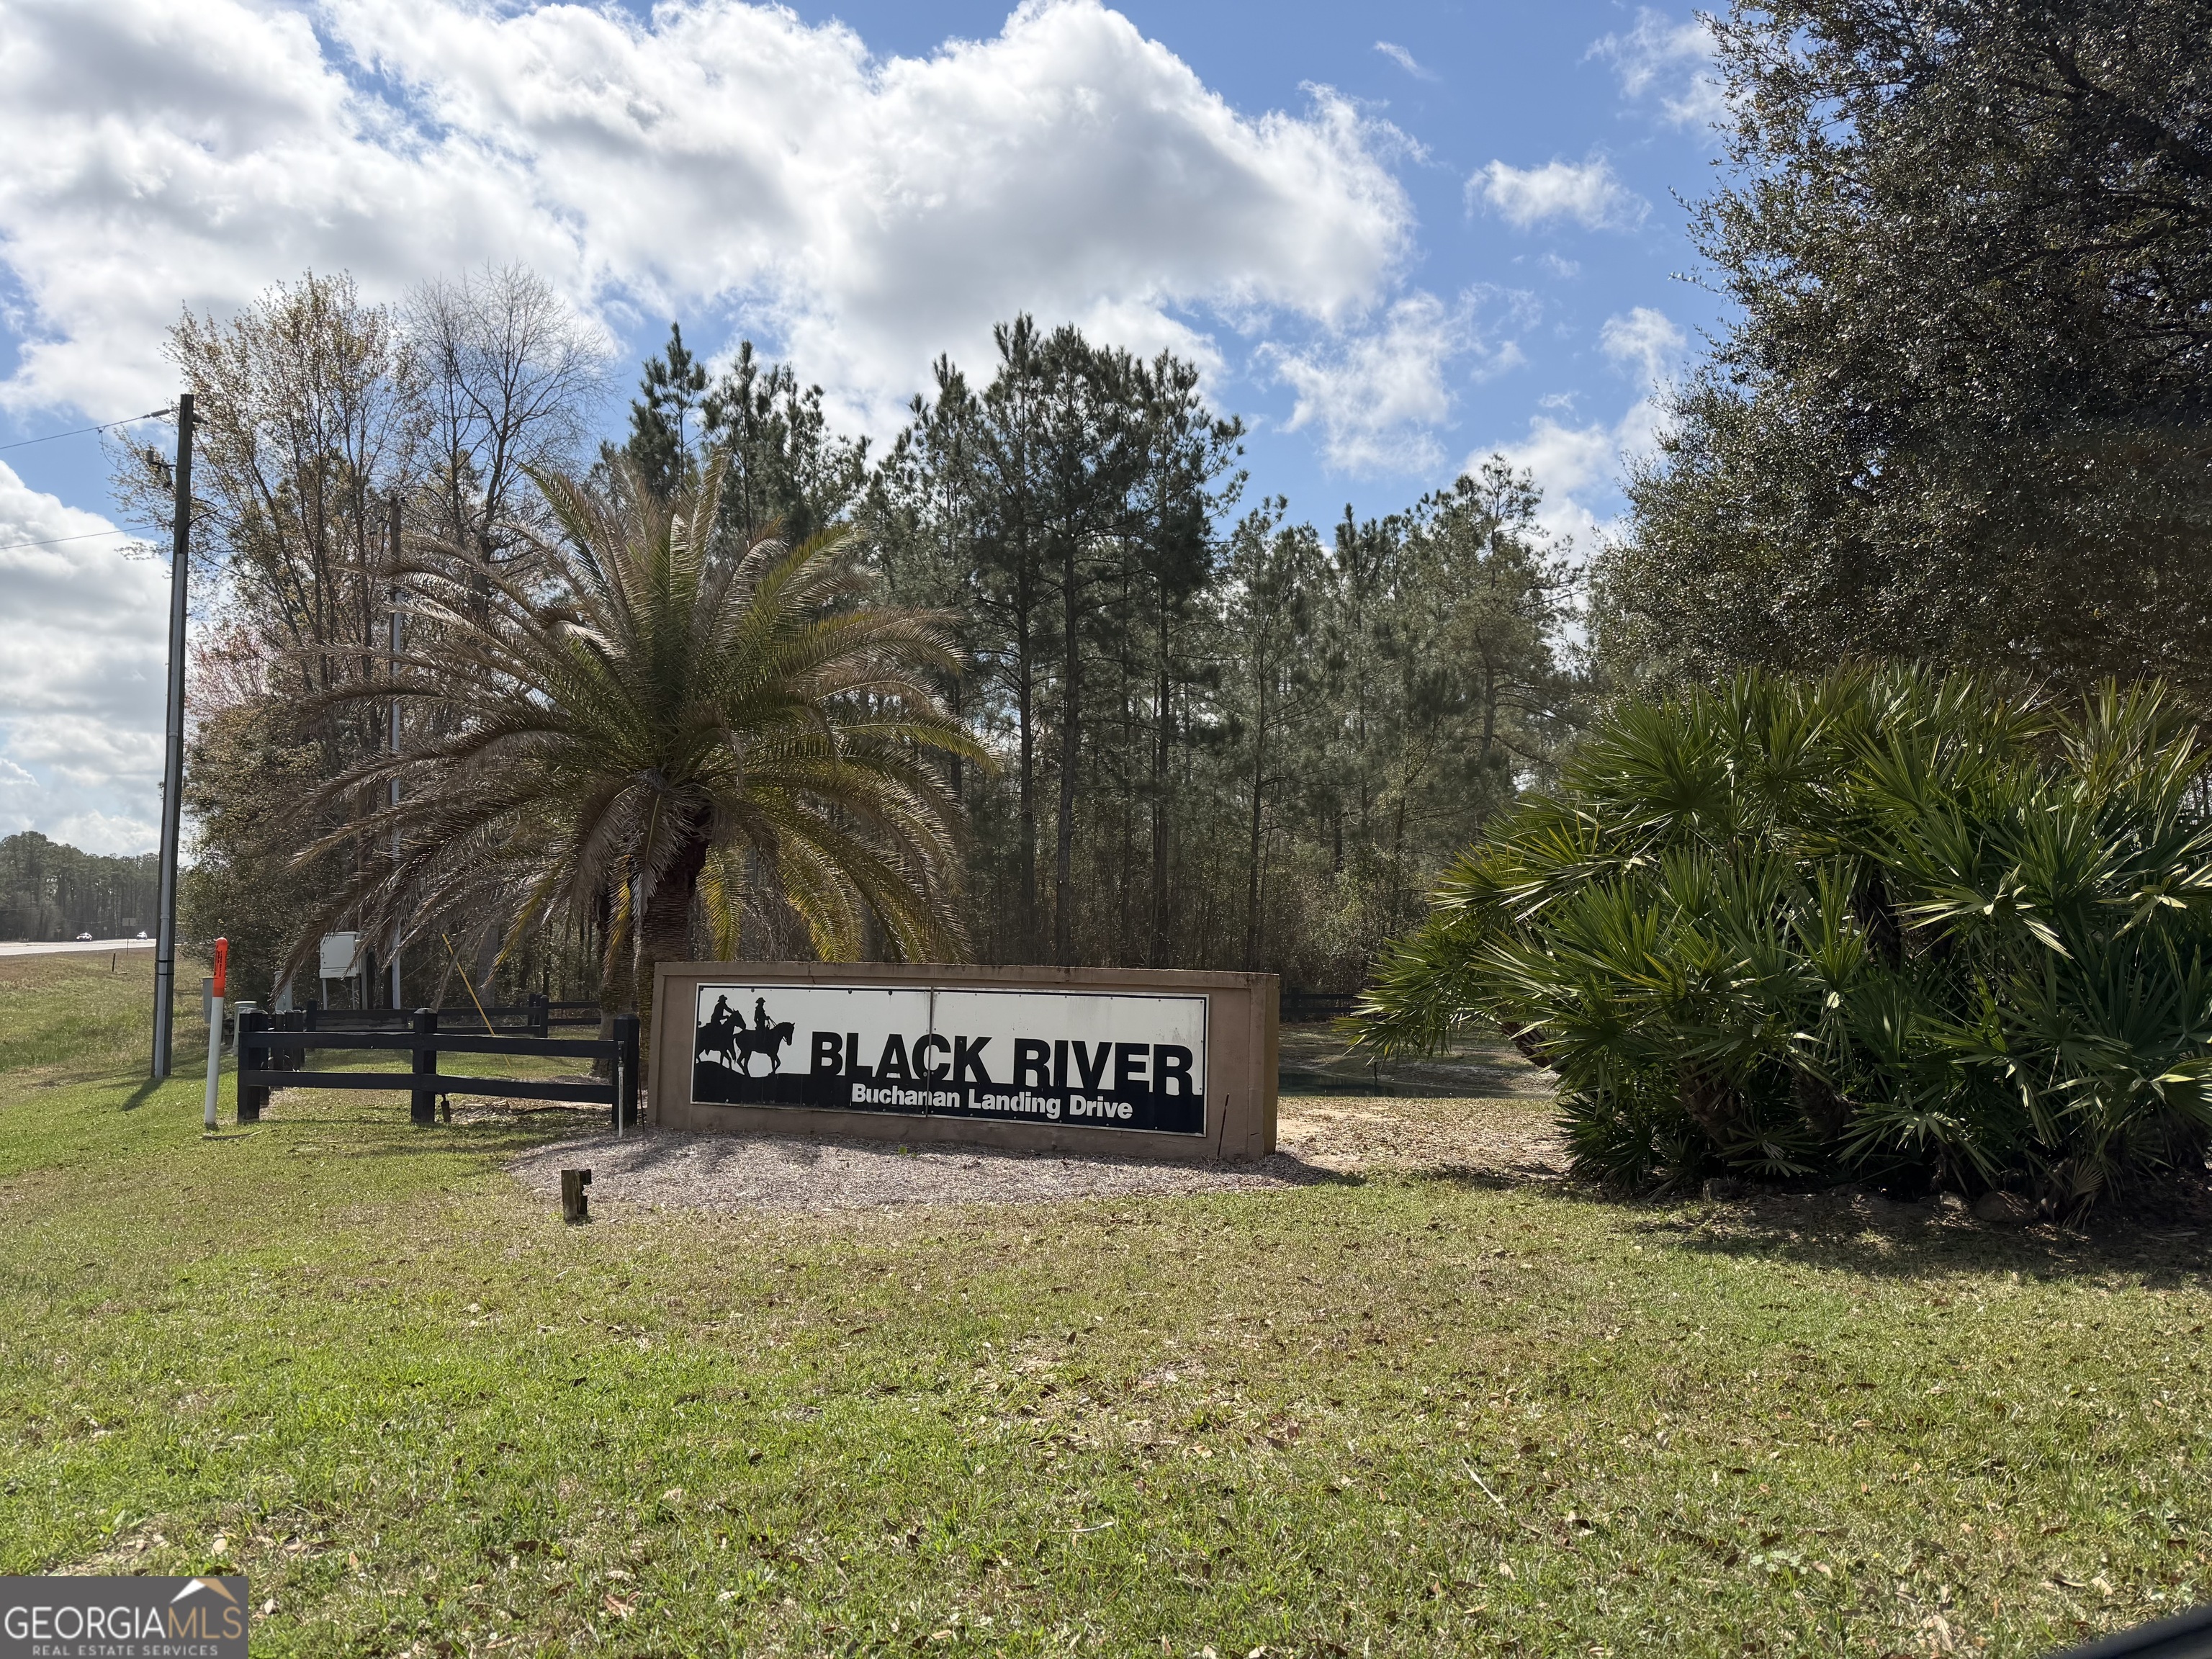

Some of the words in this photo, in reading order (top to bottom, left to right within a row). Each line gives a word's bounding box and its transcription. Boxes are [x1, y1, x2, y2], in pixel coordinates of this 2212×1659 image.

[811, 1031, 993, 1083] BLACK
[1013, 1038, 1195, 1095] RIVER
[852, 1082, 960, 1108] Buchanan
[968, 1088, 1061, 1120] Landing
[1069, 1094, 1133, 1120] Drive
